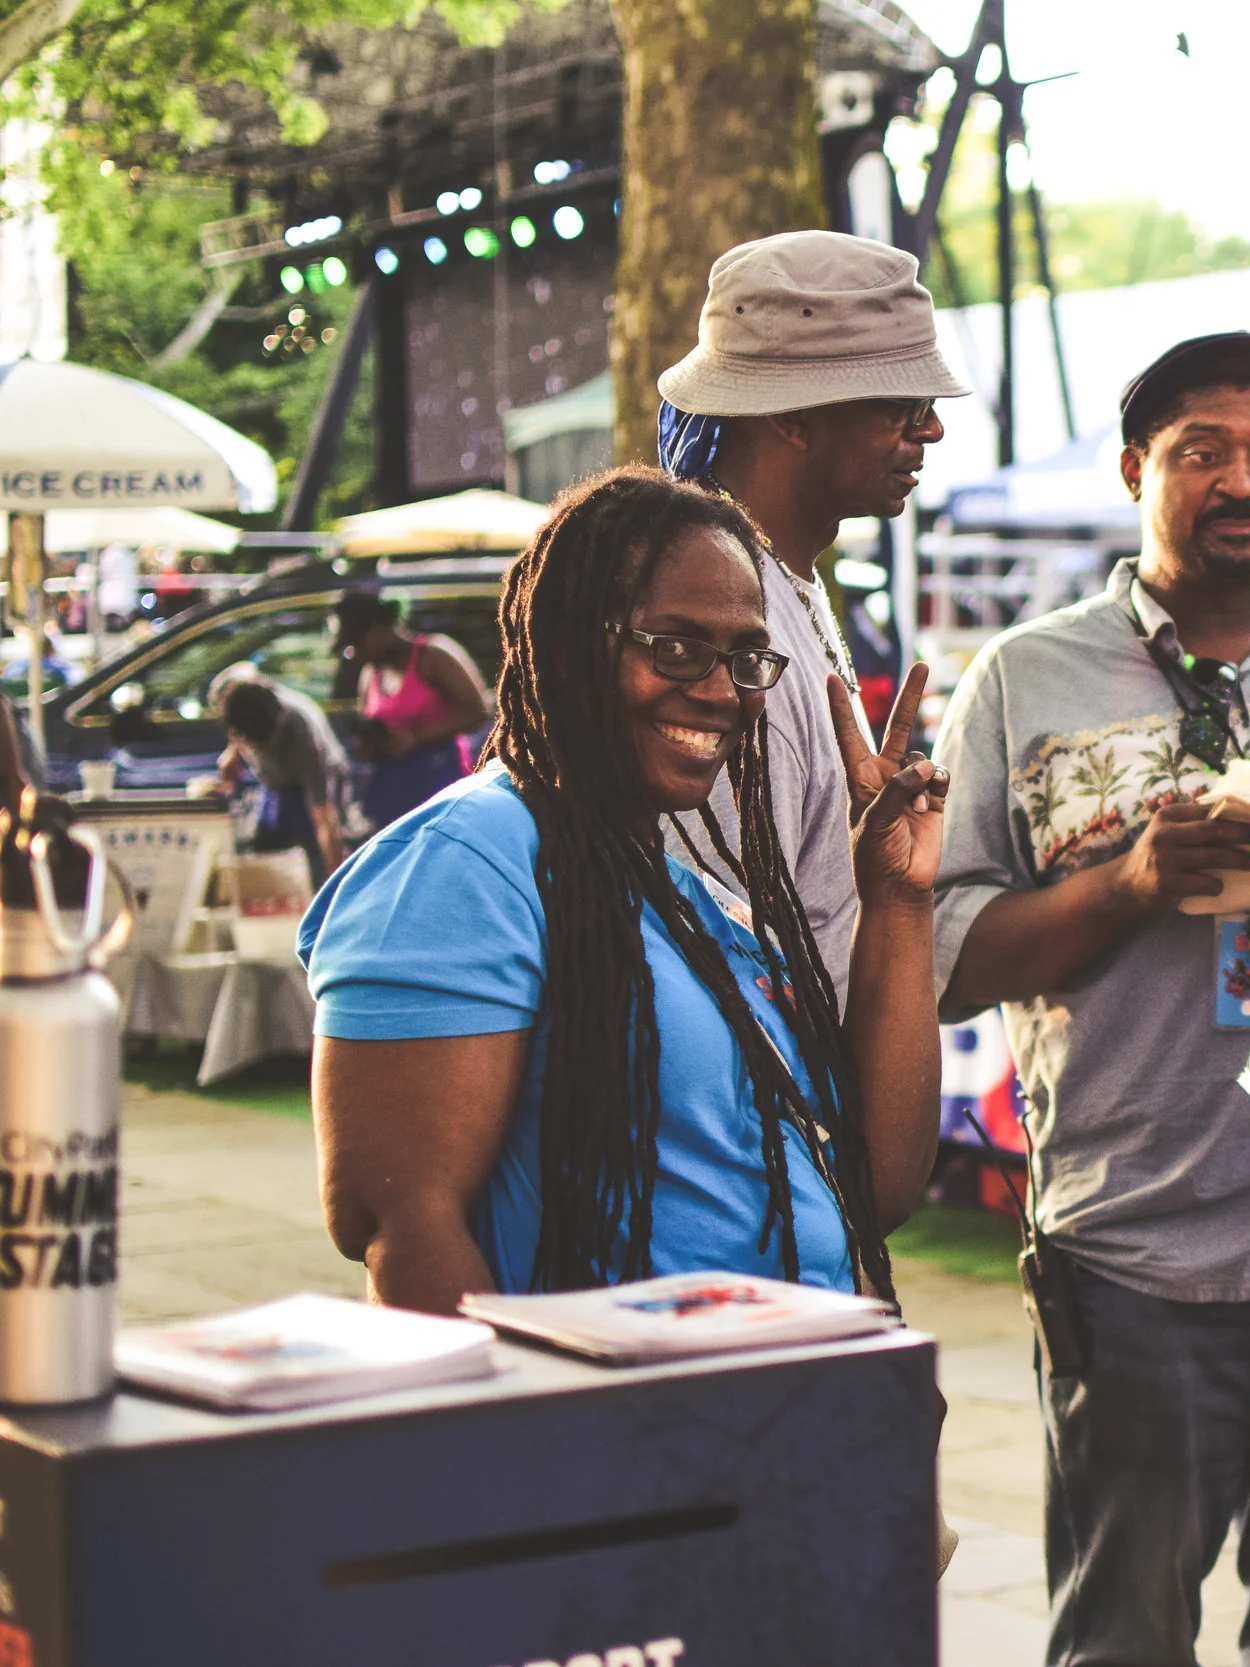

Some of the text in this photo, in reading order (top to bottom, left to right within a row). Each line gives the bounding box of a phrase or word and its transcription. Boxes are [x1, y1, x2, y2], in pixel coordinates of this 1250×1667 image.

[2, 470, 204, 498] ICE CREAM
[0, 1230, 118, 1289] STAG
